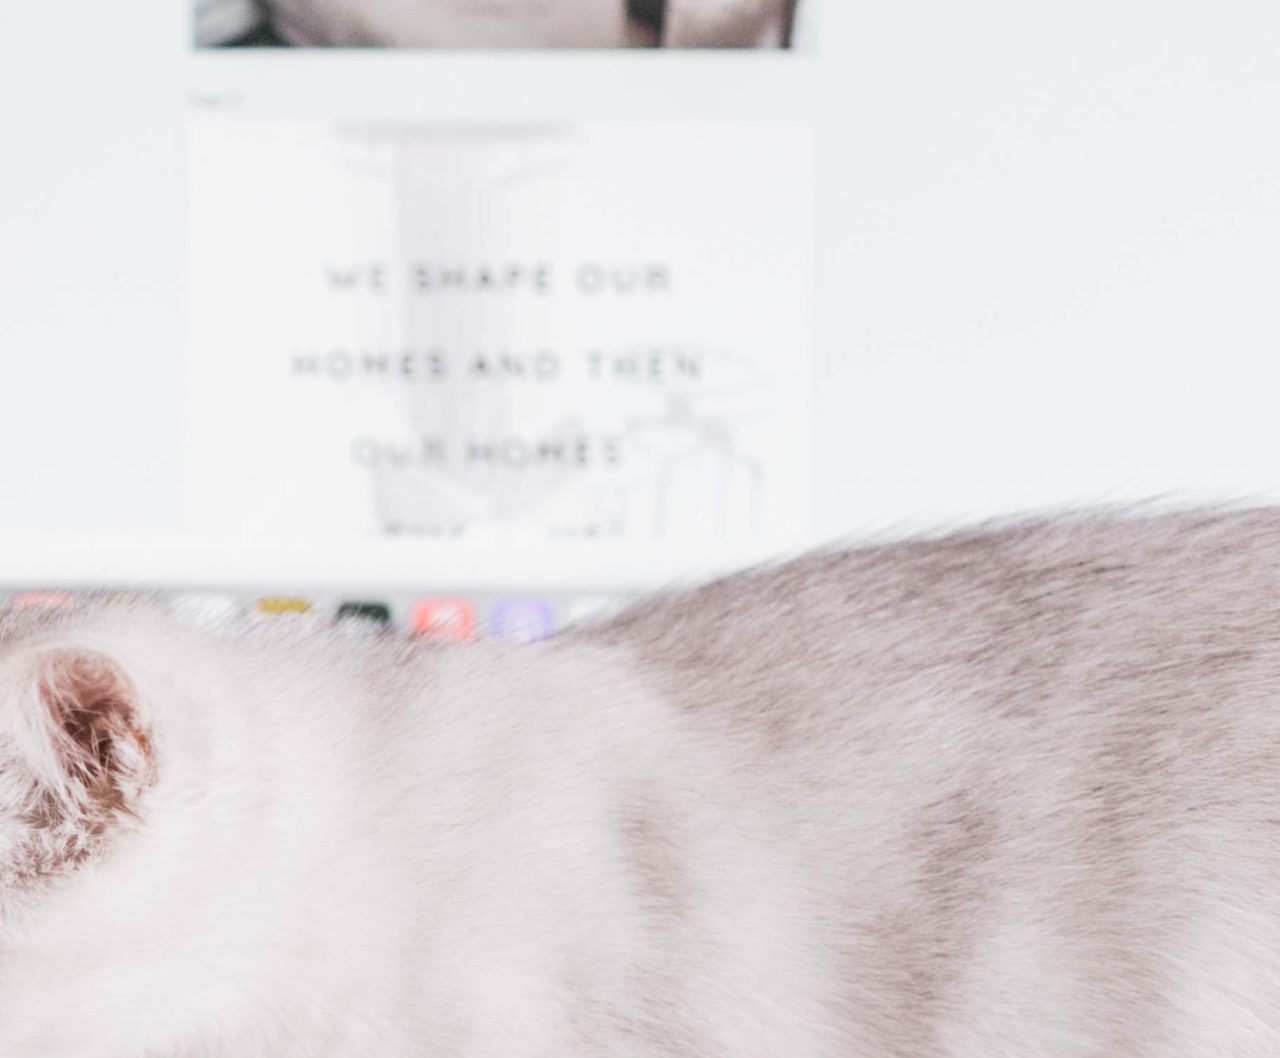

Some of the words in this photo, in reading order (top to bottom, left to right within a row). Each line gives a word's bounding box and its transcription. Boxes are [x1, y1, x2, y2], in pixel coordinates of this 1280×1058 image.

[324, 261, 387, 294] WE
[411, 261, 553, 294] SHAPE
[574, 261, 673, 294] OUR
[290, 347, 448, 381] HOMES
[468, 347, 562, 381] AND
[585, 347, 704, 381] THEN
[349, 434, 447, 469] OUR
[466, 434, 624, 469] HOMES
